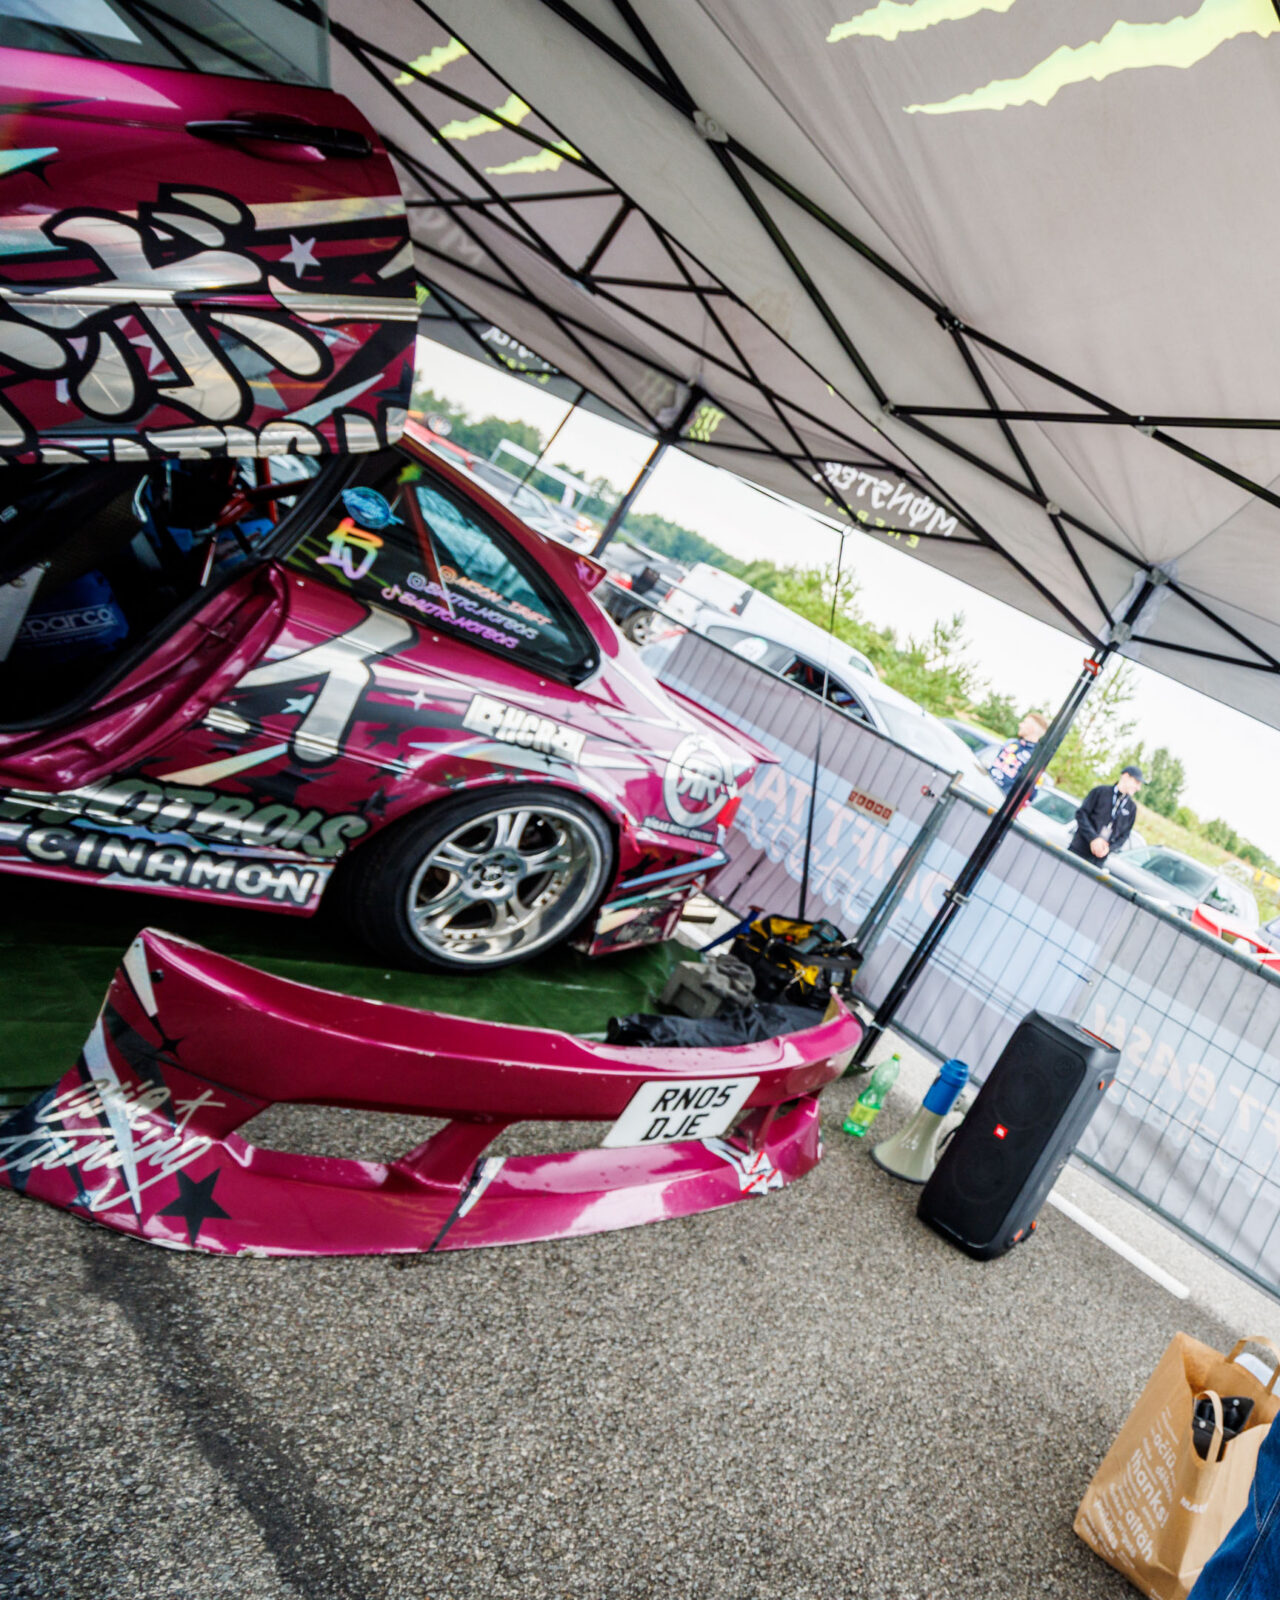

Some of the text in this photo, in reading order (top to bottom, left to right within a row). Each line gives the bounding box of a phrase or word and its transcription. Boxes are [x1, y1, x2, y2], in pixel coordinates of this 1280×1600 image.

[18, 604, 114, 643] parco
[25, 827, 316, 905] CINAMON
[651, 1084, 739, 1113] RN05
[640, 1113, 710, 1142] DJE
[1130, 1448, 1169, 1529] thanks!
